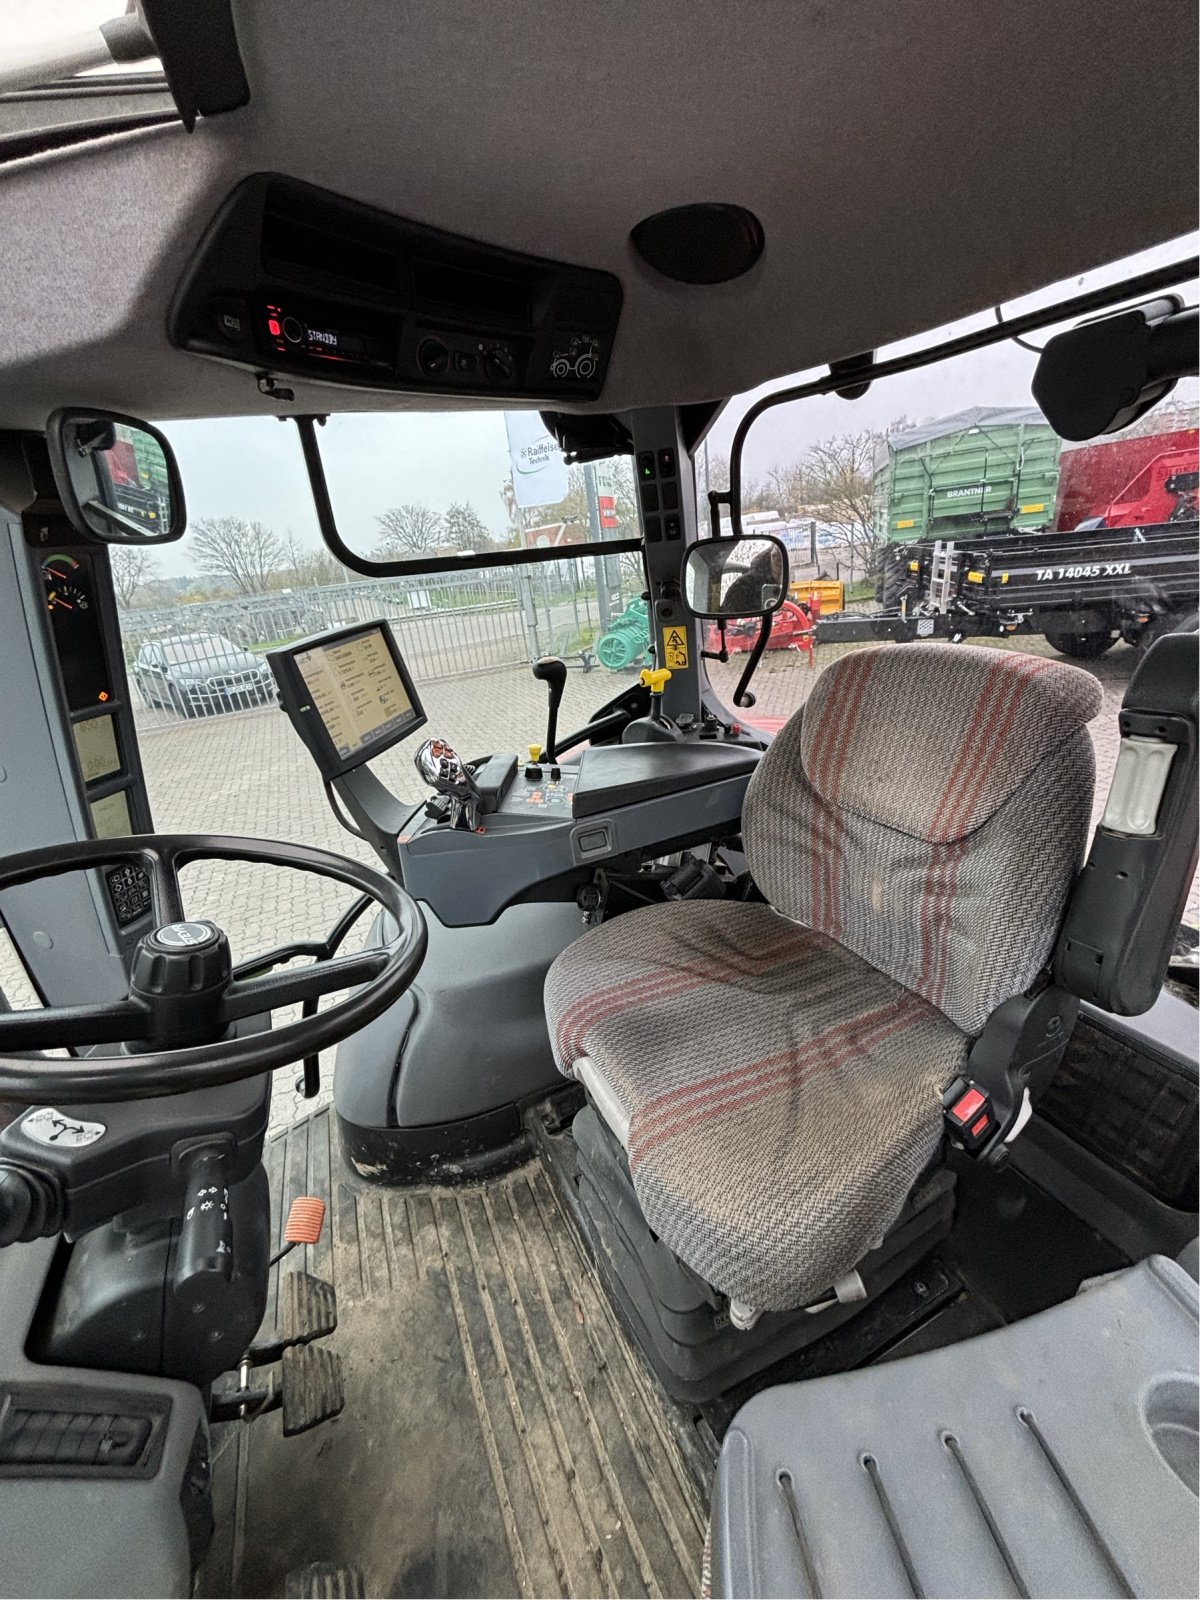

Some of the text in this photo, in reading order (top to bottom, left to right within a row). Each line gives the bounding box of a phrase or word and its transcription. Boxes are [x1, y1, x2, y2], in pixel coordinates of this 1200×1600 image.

[308, 329, 337, 345] STANDBY
[527, 442, 560, 457] Raiffeise
[528, 454, 550, 465] Technik
[947, 485, 992, 498] BRANTNER
[1036, 563, 1131, 581] TA 14045 XXL
